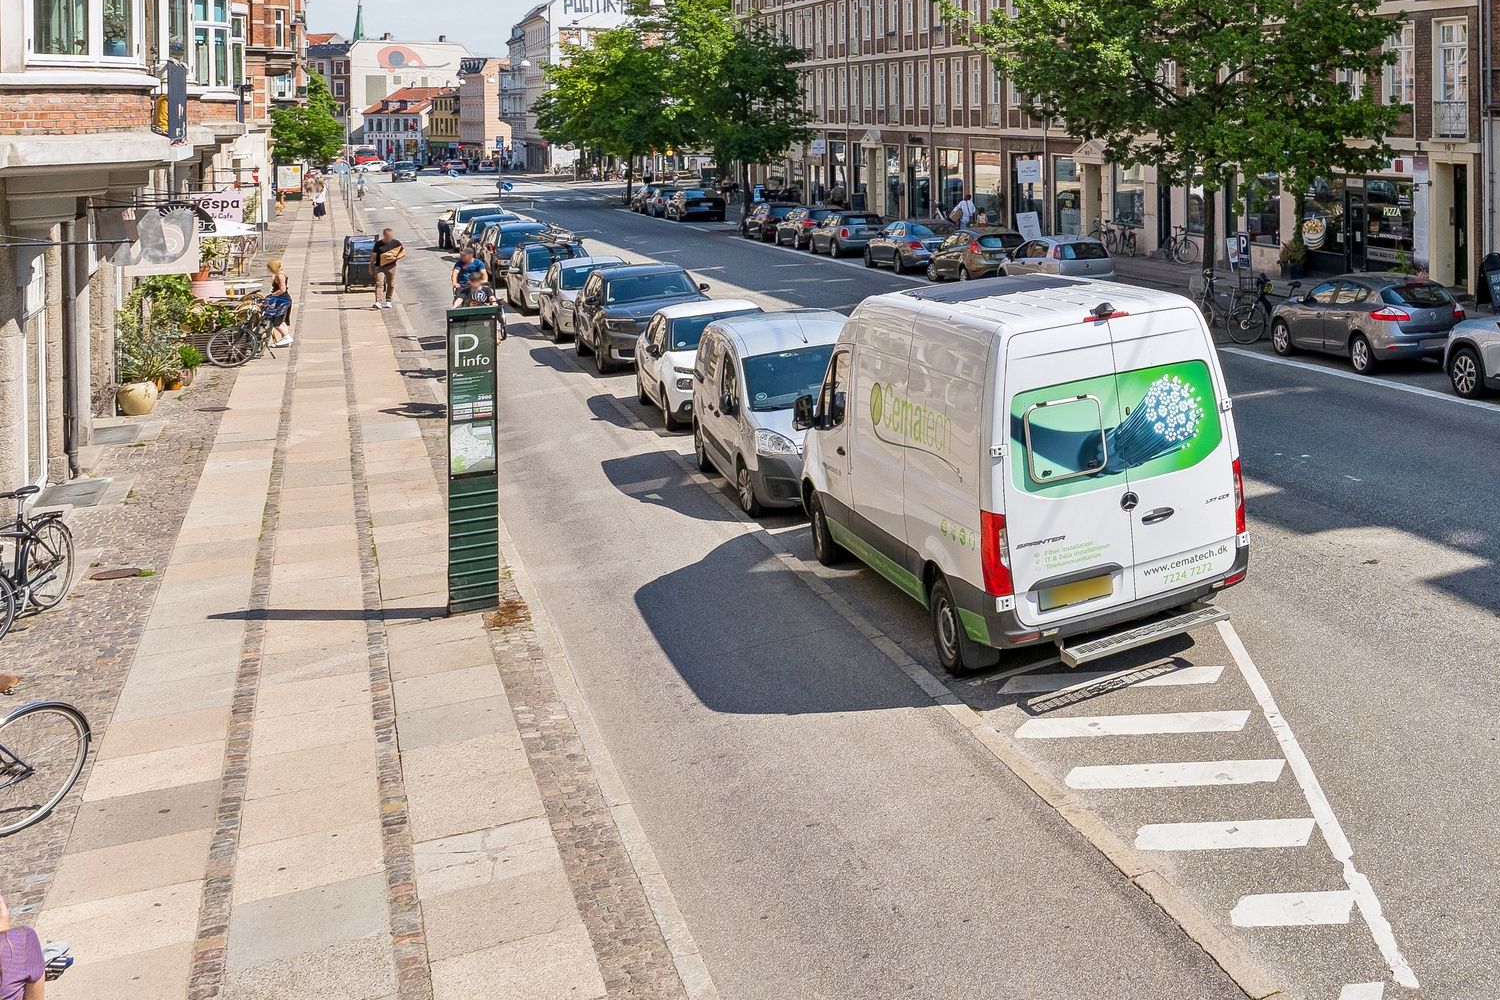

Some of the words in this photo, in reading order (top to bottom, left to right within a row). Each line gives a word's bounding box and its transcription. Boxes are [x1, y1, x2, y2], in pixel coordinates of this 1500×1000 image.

[1444, 143, 1457, 151] 167
[1383, 207, 1402, 217] PIZZA
[1240, 236, 1247, 253] P
[454, 333, 480, 368] P
[462, 354, 490, 368] info
[882, 382, 953, 454] Cematech
[1015, 535, 1066, 550] SPRINTER
[1044, 548, 1060, 556] Fiber
[1058, 552, 1073, 560] Data
[1046, 553, 1102, 570] Telekommunikation
[1143, 545, 1229, 576] www.cematech.dk
[1163, 570, 1187, 585] 7224
[1190, 562, 1213, 577] 7272
